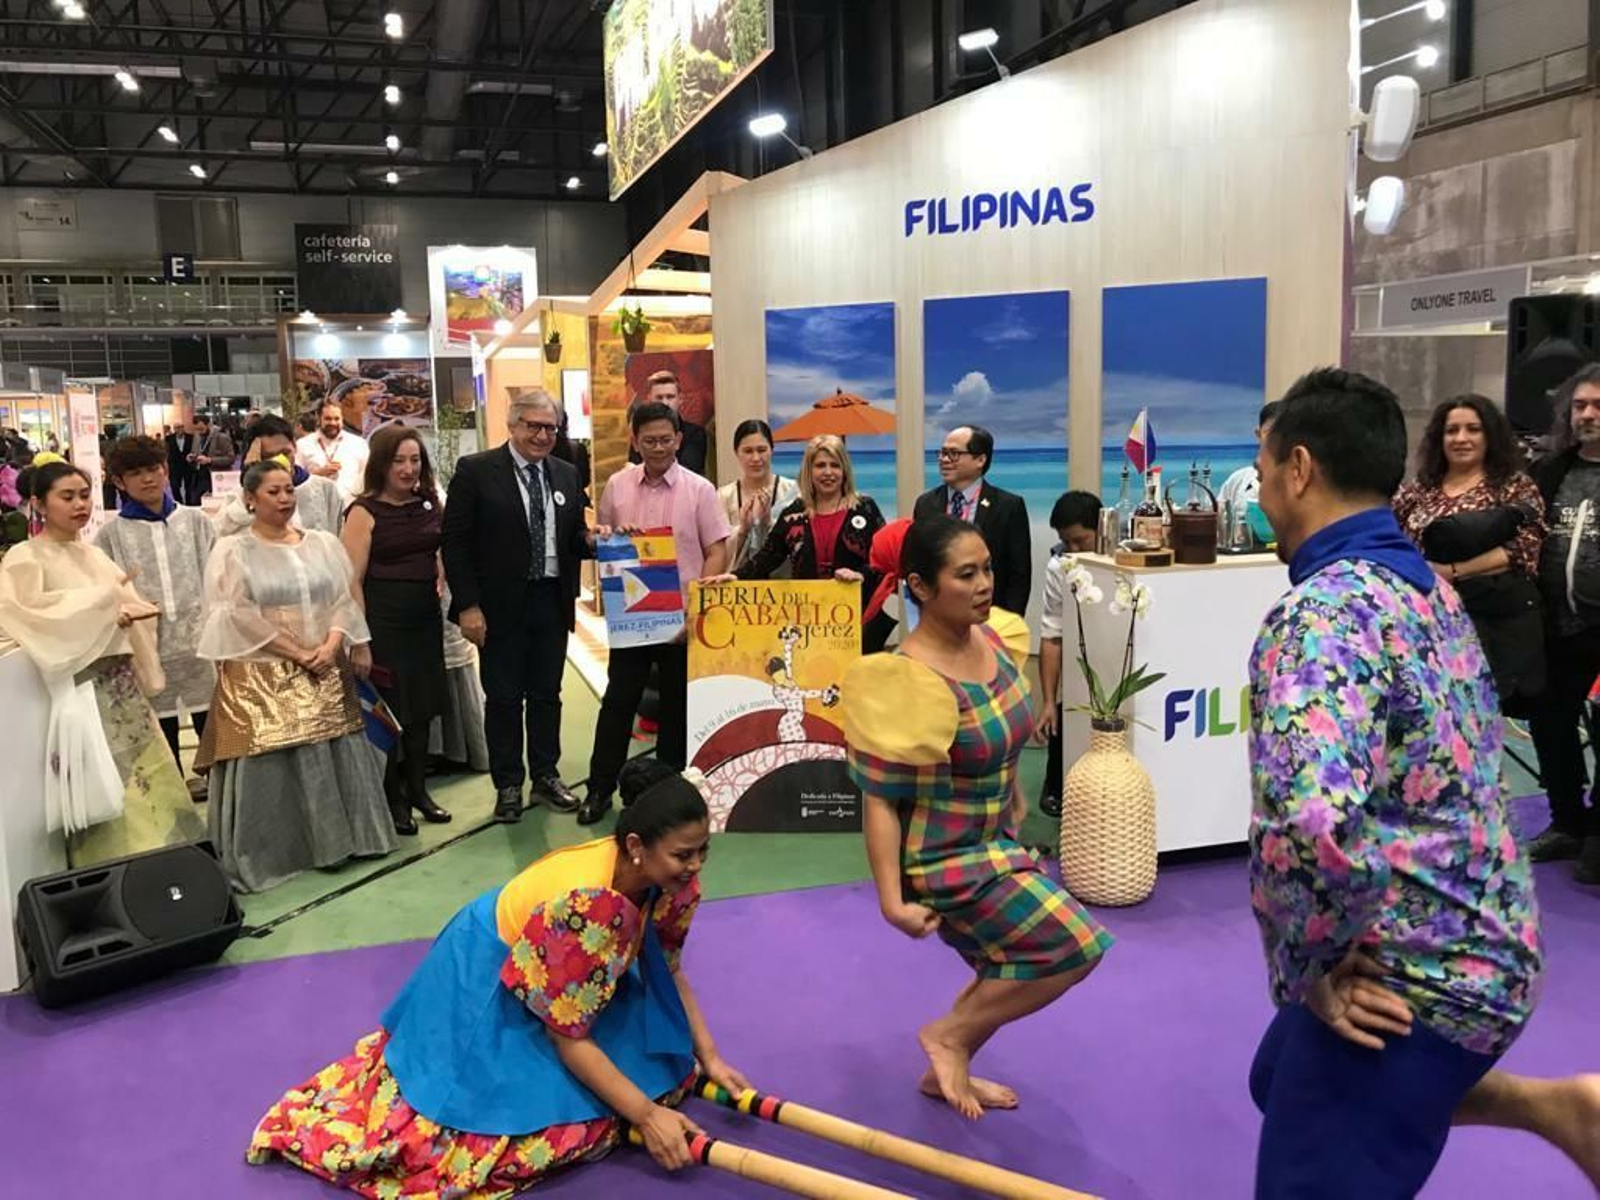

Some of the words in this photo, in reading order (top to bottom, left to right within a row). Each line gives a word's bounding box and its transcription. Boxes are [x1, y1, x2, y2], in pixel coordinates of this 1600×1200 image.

[905, 183, 1095, 237] FILIPINAS
[171, 256, 186, 277] E
[1411, 292, 1455, 311] ONLYONE
[1458, 287, 1497, 306] TRAVEL
[697, 586, 777, 615] FERIA
[695, 603, 854, 650] CABALLO
[798, 622, 854, 649] Jerez
